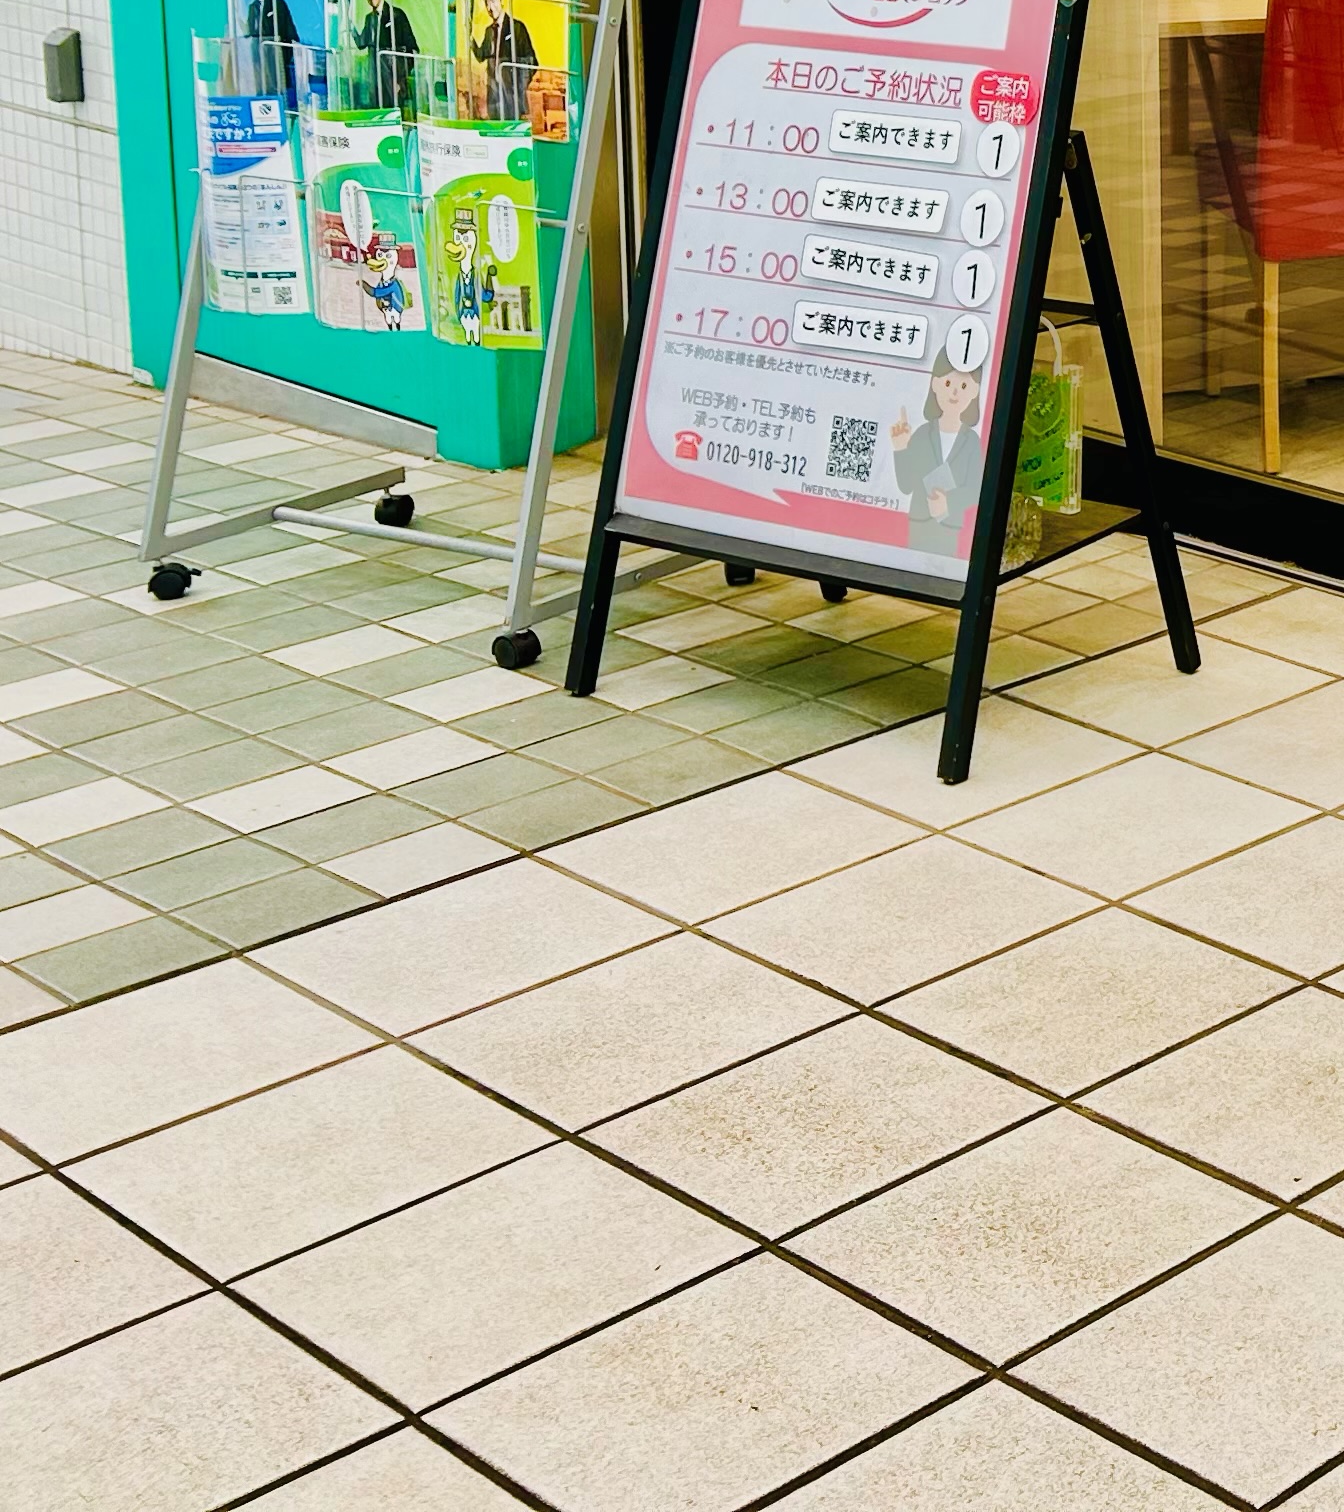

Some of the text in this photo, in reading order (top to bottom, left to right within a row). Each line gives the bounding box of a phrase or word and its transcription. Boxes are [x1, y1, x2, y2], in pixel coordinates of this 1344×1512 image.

[765, 58, 964, 107] 本日のご予約状況
[979, 75, 1029, 99] ご案内
[838, 121, 954, 151] ご案内できます
[991, 134, 1005, 170] 1
[821, 187, 941, 220] ご案内できます
[975, 202, 989, 240] 1
[811, 246, 932, 285] ご案内できます
[966, 264, 979, 299] 1
[802, 310, 921, 346] ご案内できます
[961, 329, 974, 364] 1
[706, 441, 807, 476] 0120-918-312
